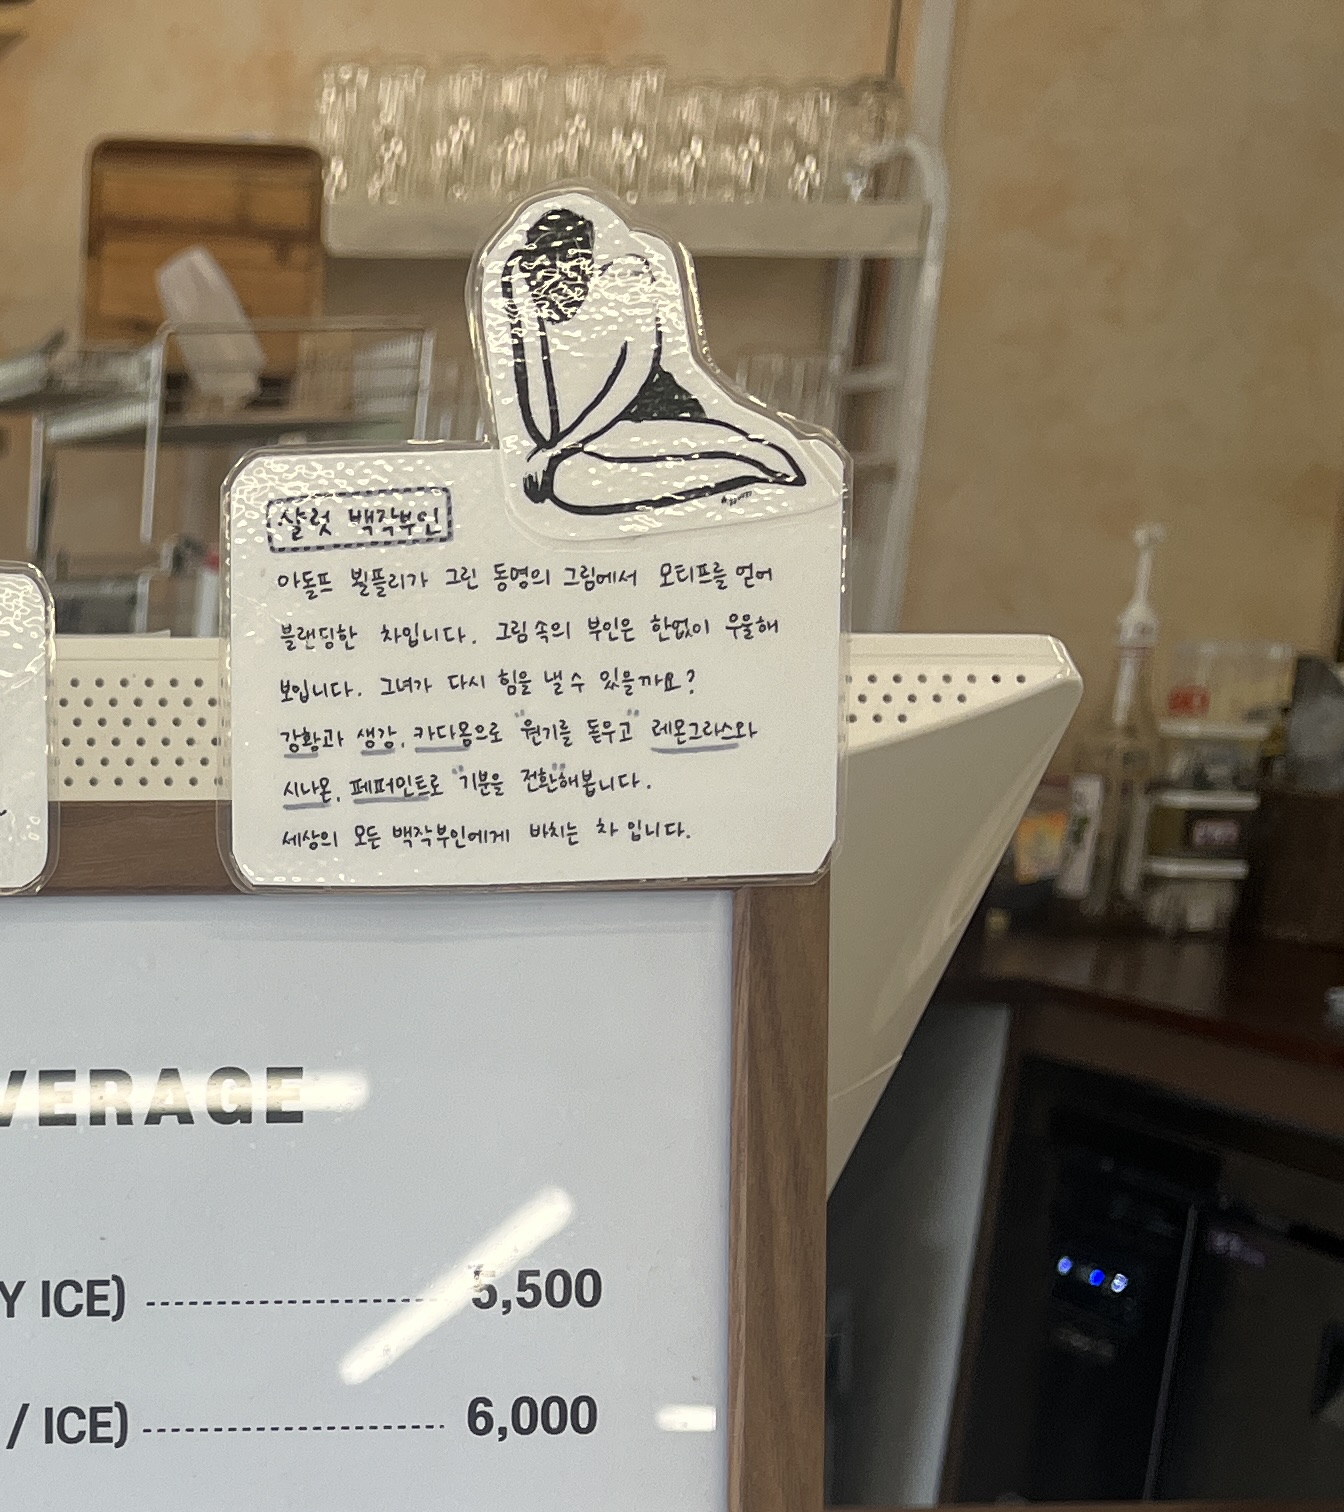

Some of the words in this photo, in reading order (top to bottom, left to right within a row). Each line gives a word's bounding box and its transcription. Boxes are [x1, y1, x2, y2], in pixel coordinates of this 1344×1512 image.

[281, 679, 361, 703] 보입니다.
[381, 677, 432, 695] 그녀가
[448, 674, 485, 689] 다시
[498, 669, 531, 695] 힘을
[600, 668, 695, 696] 있을까요?
[283, 830, 337, 850] 세상의
[355, 825, 381, 849] 모든
[393, 824, 509, 848] 백작부인에게
[530, 822, 578, 846] 바치는
[42, 1274, 125, 1322] ICE)
